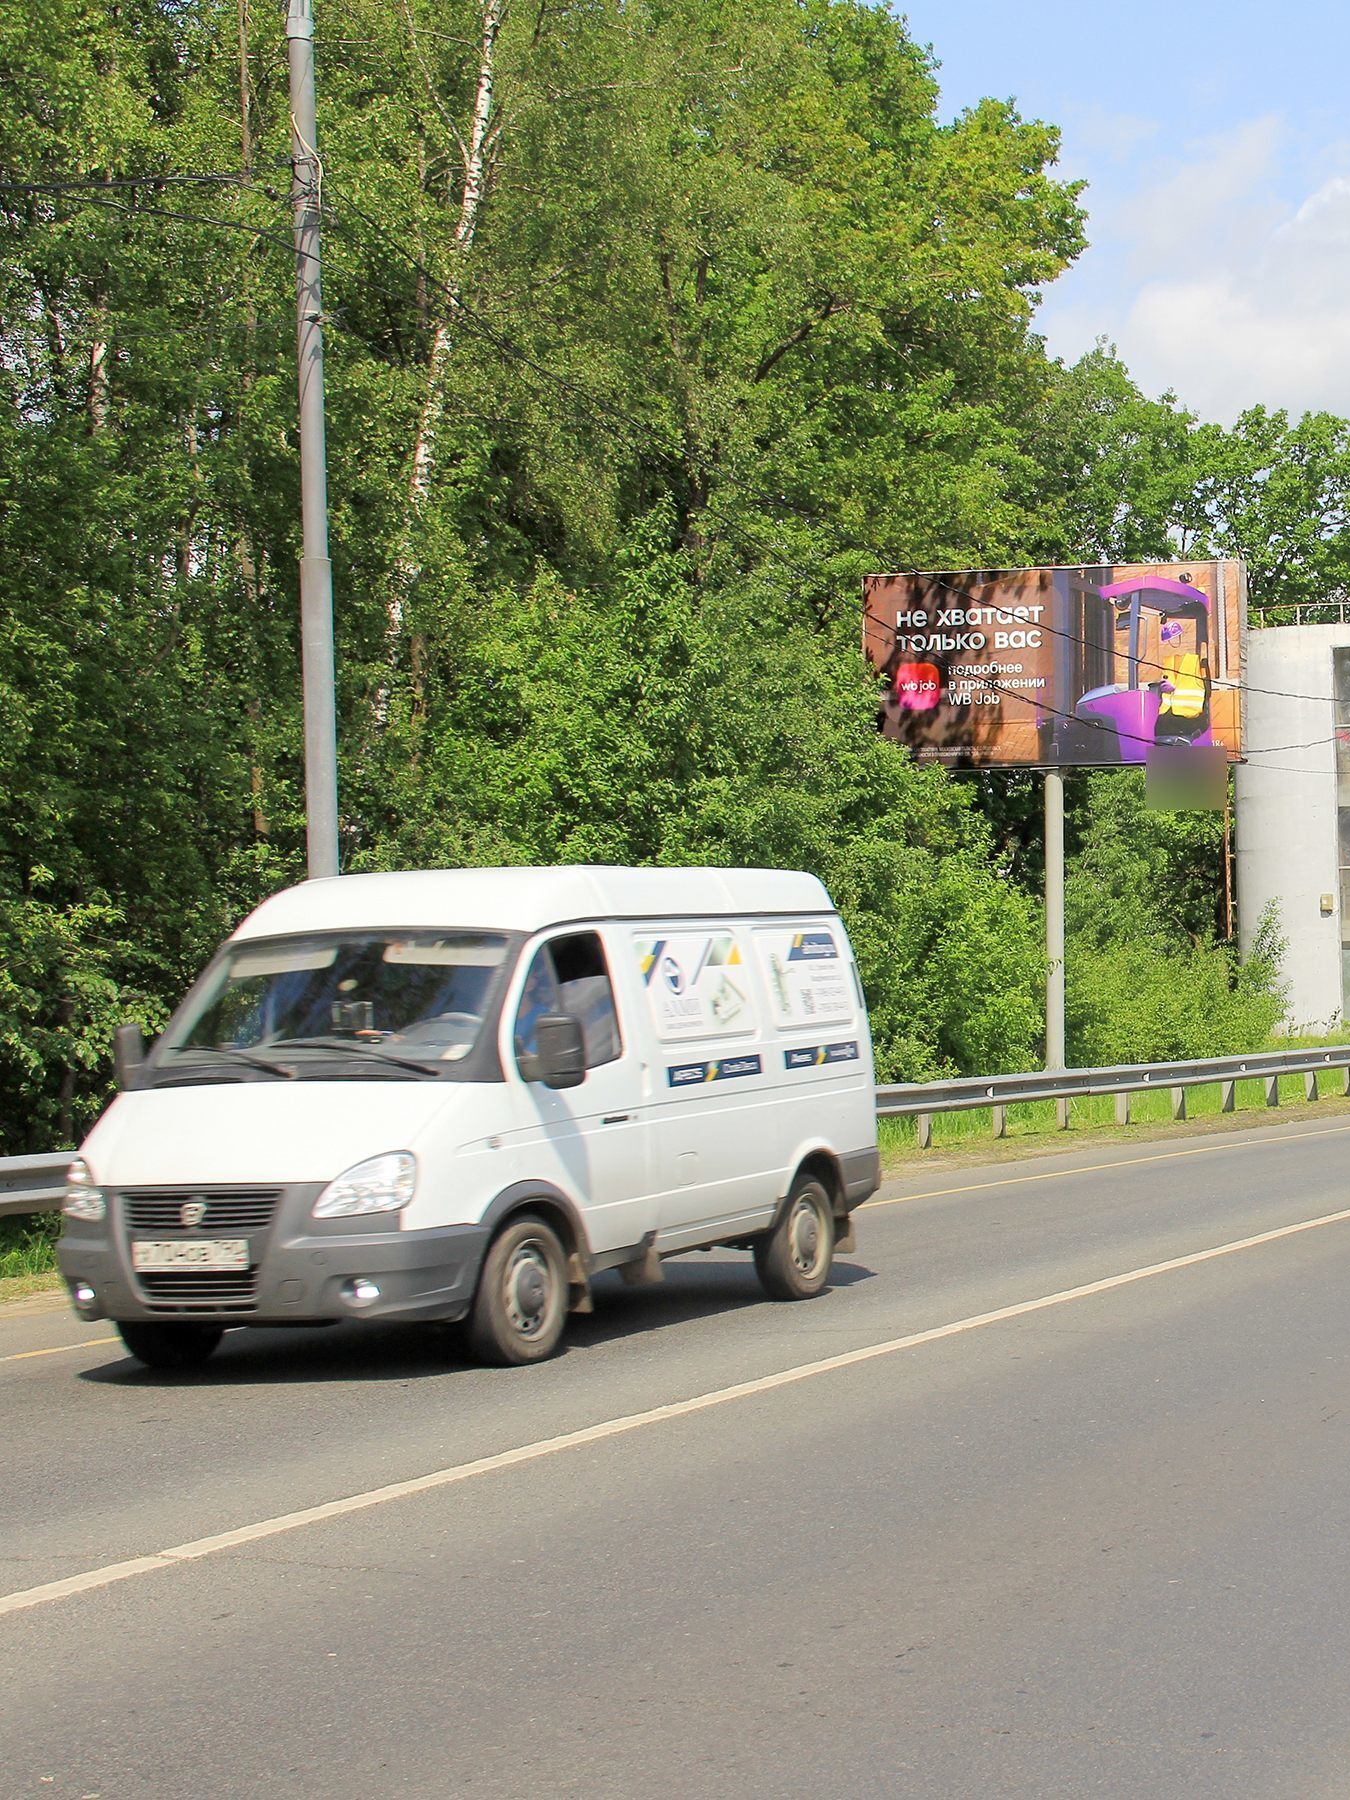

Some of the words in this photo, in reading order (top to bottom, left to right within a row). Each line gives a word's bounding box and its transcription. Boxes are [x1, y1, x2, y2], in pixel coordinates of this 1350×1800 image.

[896, 609, 928, 628] не
[936, 605, 1044, 627] хватает
[896, 630, 986, 652] только
[994, 629, 1042, 649] вас
[948, 661, 1023, 677] подробнее
[919, 680, 937, 694] job
[948, 680, 956, 690] в
[960, 677, 1045, 692] приложении
[949, 692, 972, 706] WB
[975, 692, 1000, 705] Job
